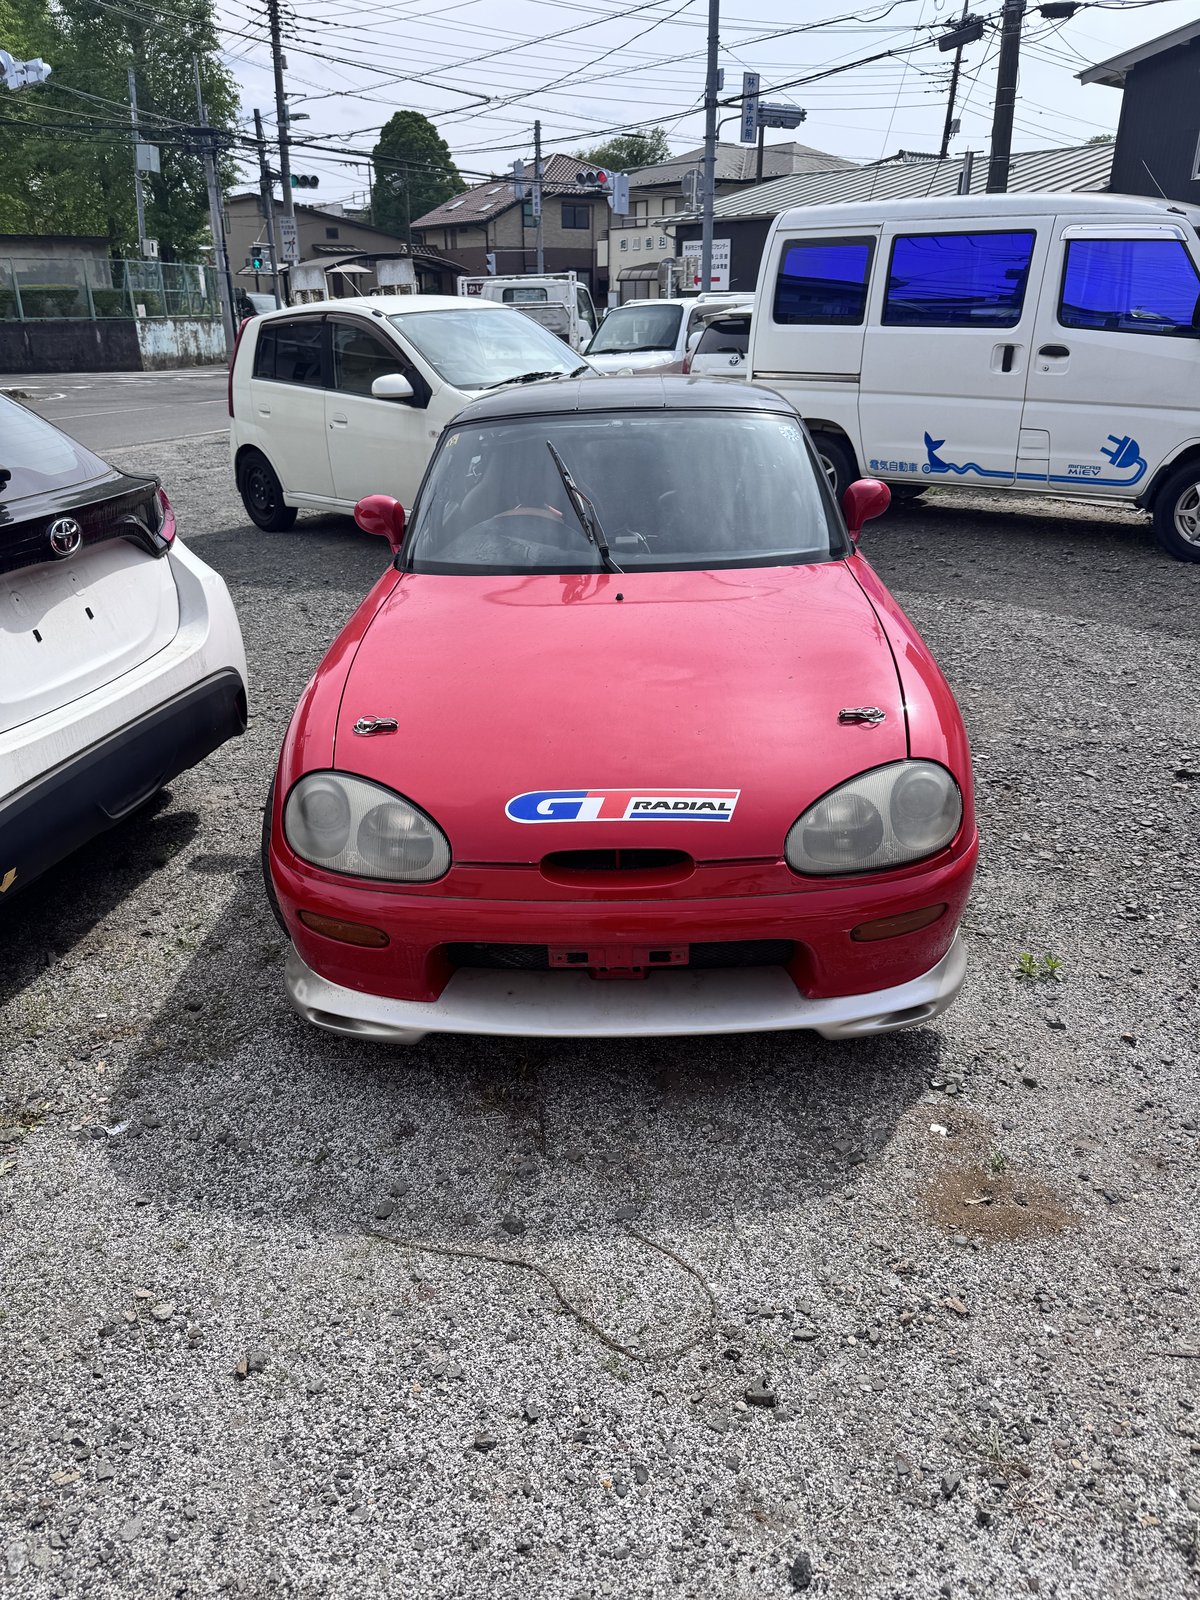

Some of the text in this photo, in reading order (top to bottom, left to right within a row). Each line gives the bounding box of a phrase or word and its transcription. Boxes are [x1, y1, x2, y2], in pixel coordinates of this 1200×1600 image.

[870, 460, 918, 472] 電気自動車
[506, 790, 731, 822] GT RADIAL
